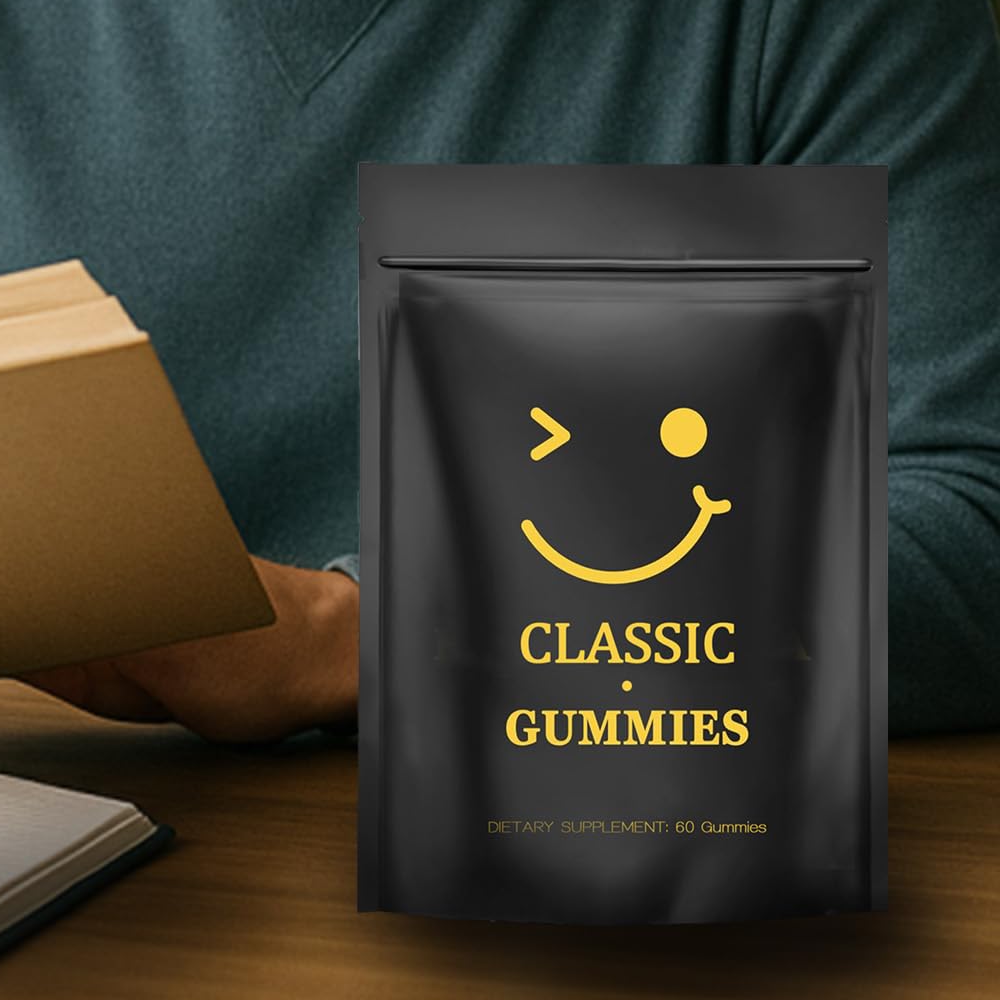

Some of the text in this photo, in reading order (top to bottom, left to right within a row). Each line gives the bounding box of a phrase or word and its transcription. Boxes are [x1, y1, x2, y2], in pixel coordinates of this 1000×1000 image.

[519, 621, 736, 665] CLASSIC
[505, 708, 750, 747] GUMMIES
[487, 820, 768, 834] DIETARY SUPPLEMENT: 60 Gummies
